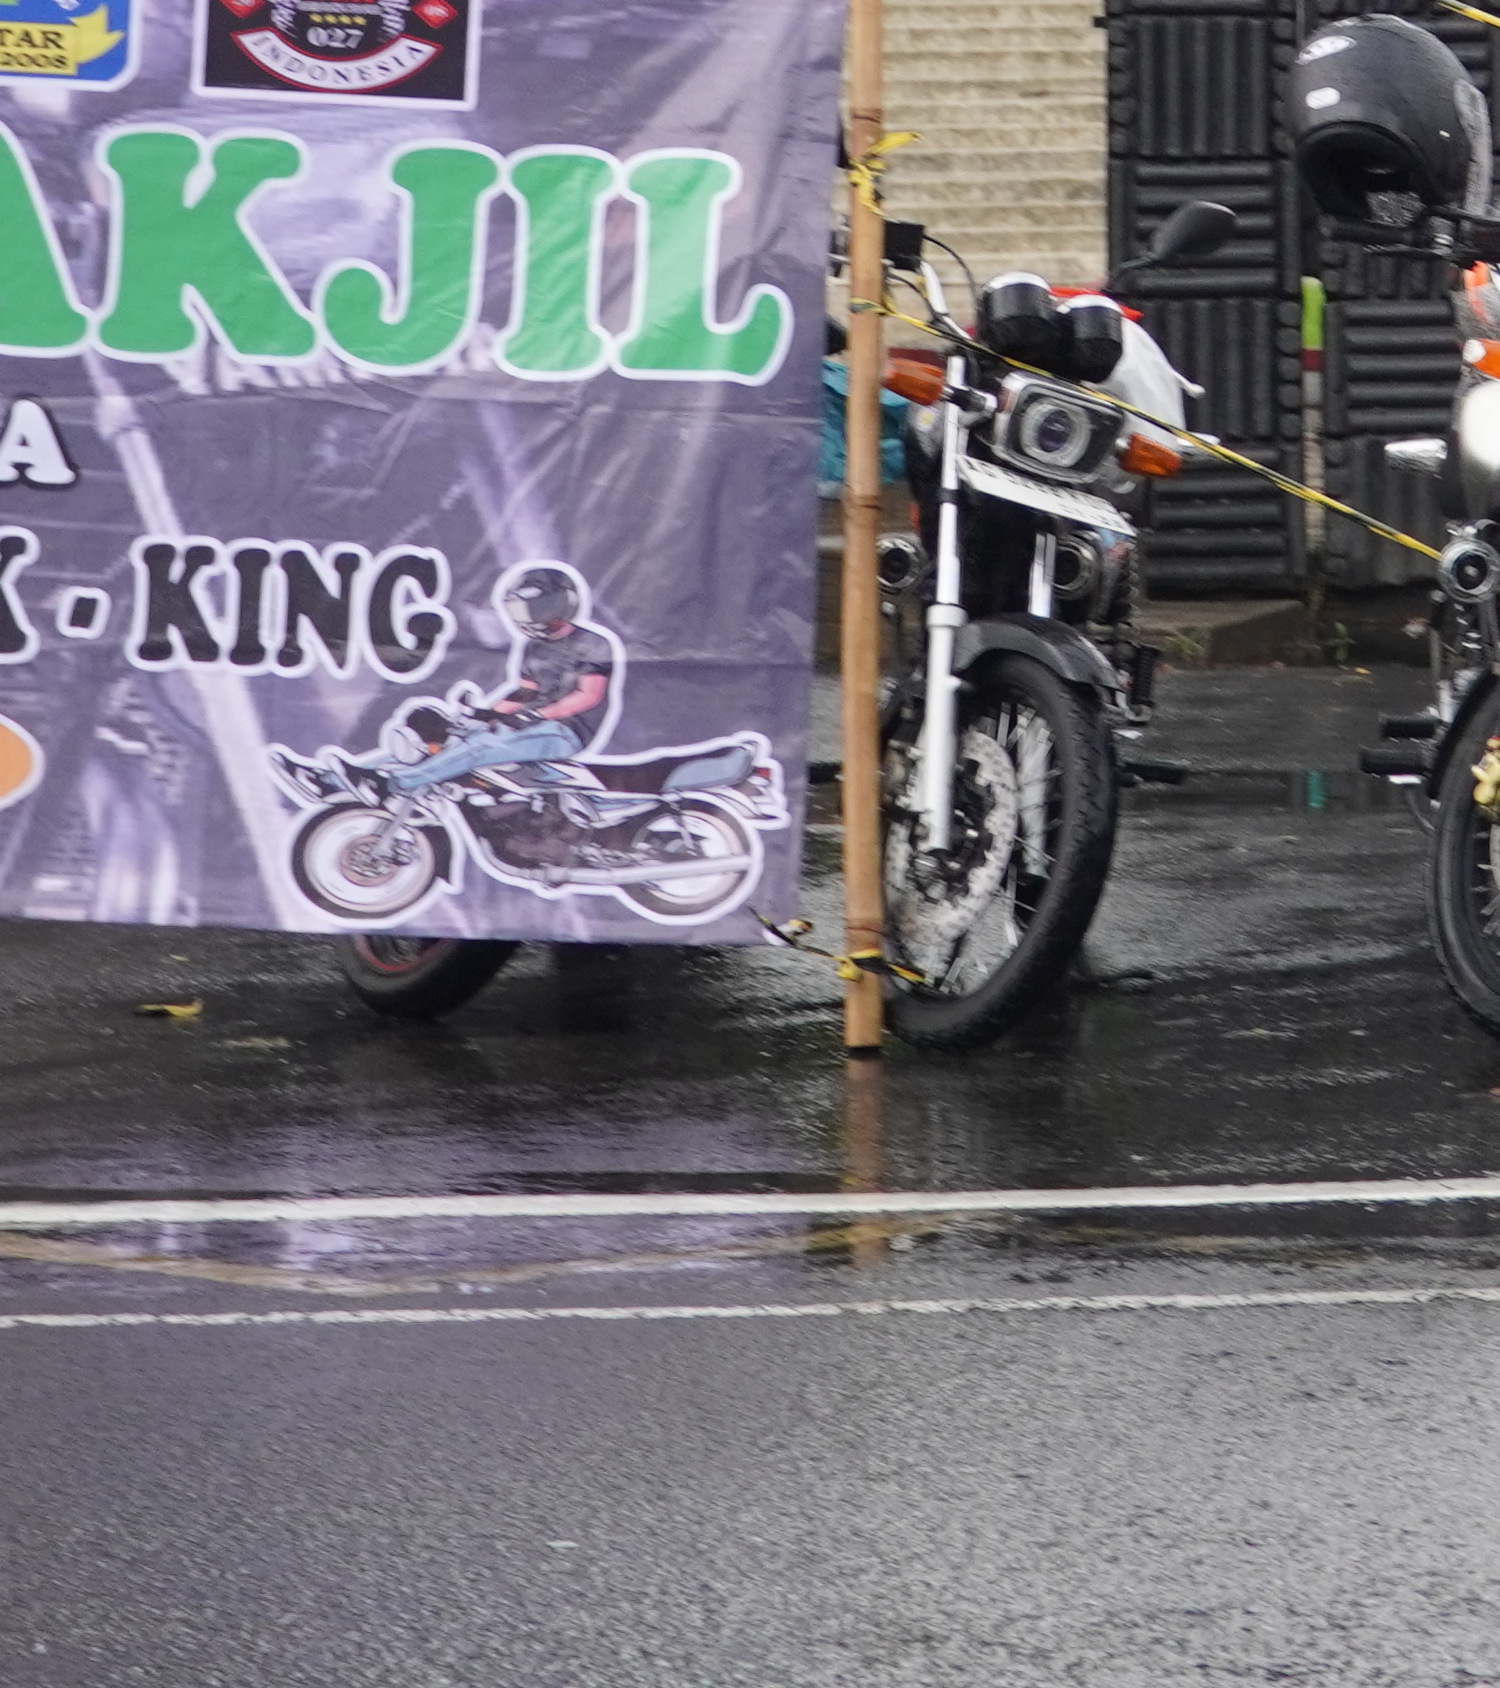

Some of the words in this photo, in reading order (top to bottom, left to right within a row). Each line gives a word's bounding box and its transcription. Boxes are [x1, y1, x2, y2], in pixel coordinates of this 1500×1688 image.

[250, 34, 425, 86] INDONESIA
[306, 26, 365, 50] 027
[134, 542, 452, 680] KING
